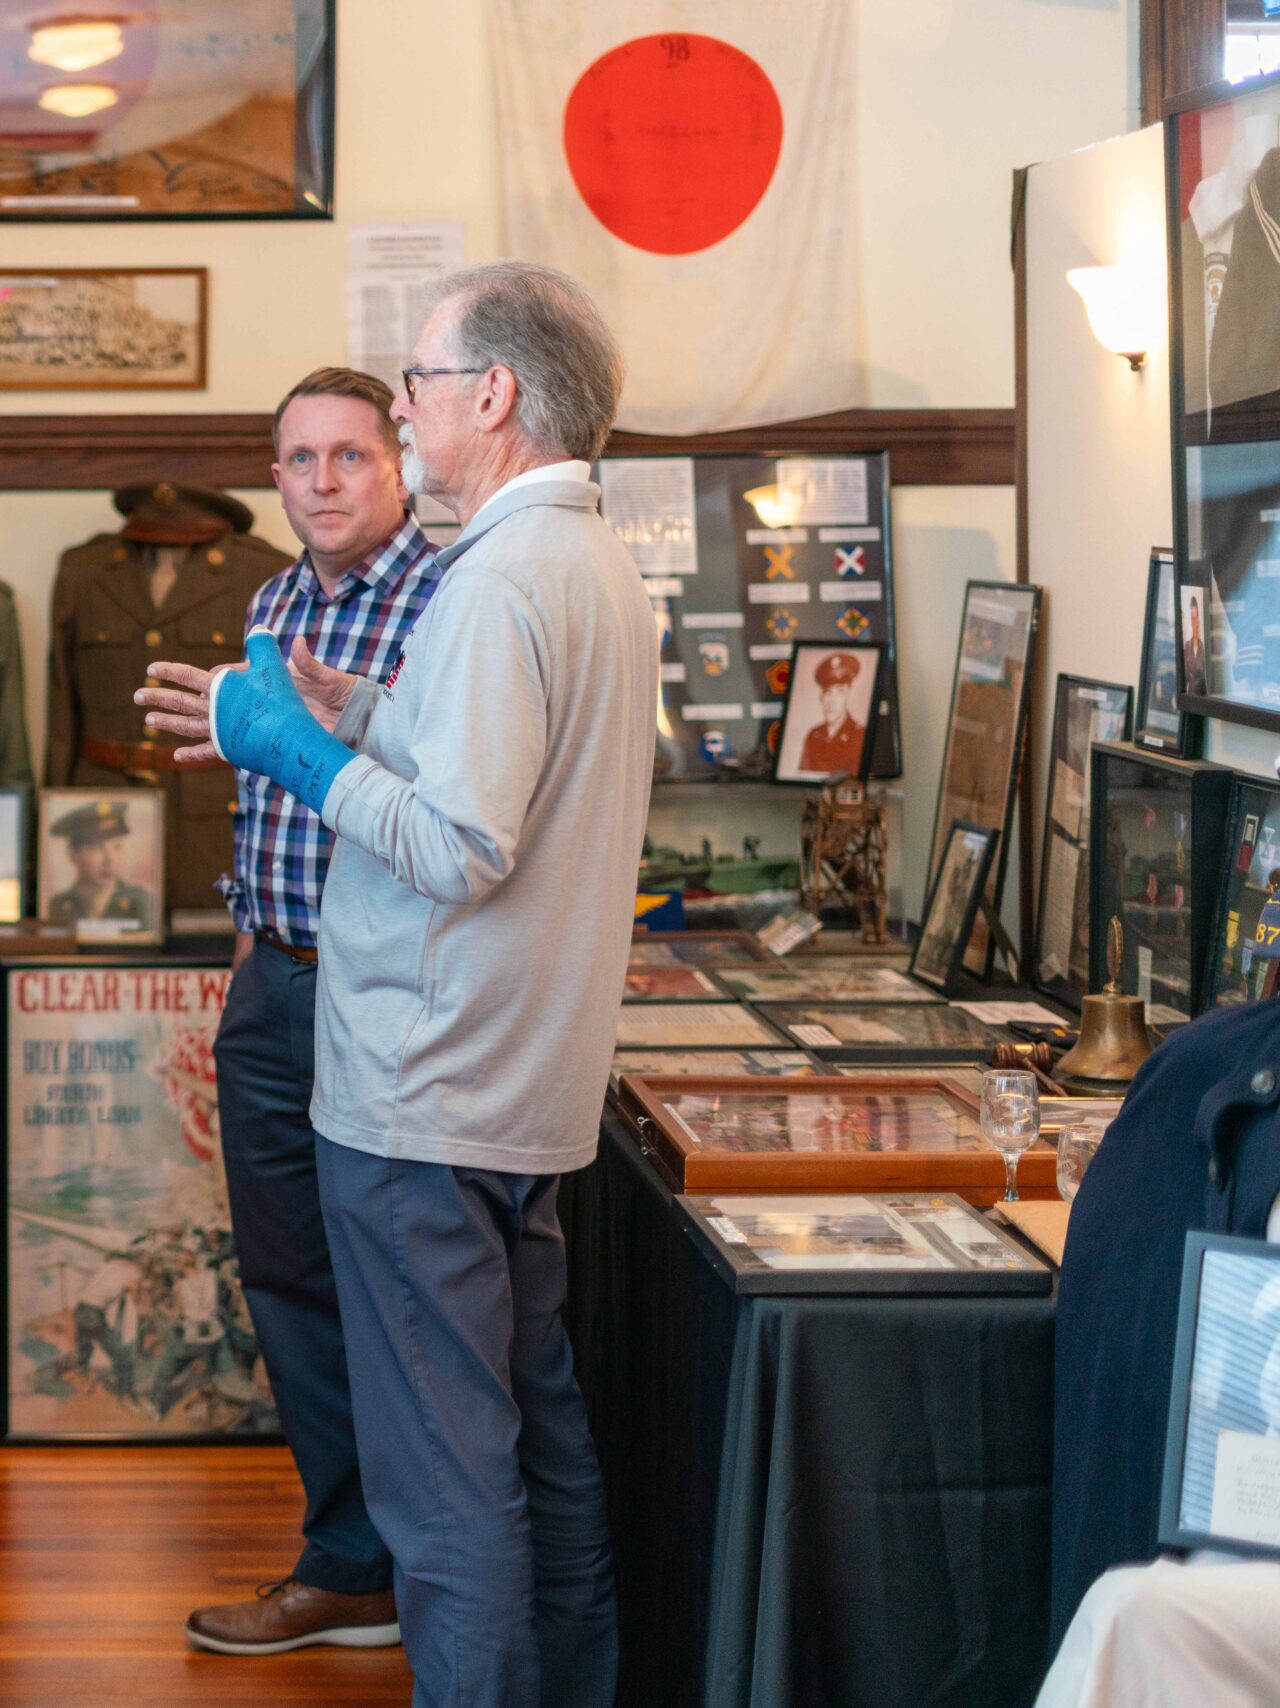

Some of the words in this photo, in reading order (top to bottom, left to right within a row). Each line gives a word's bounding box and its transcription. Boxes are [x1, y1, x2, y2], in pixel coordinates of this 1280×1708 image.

[660, 37, 691, 60] 98
[18, 972, 121, 1013] CLEAR
[127, 972, 189, 1013] THE
[198, 972, 232, 1013] W
[23, 1040, 63, 1074] BUY
[22, 1105, 89, 1125] LIBERTY
[97, 1104, 142, 1124] LOAN
